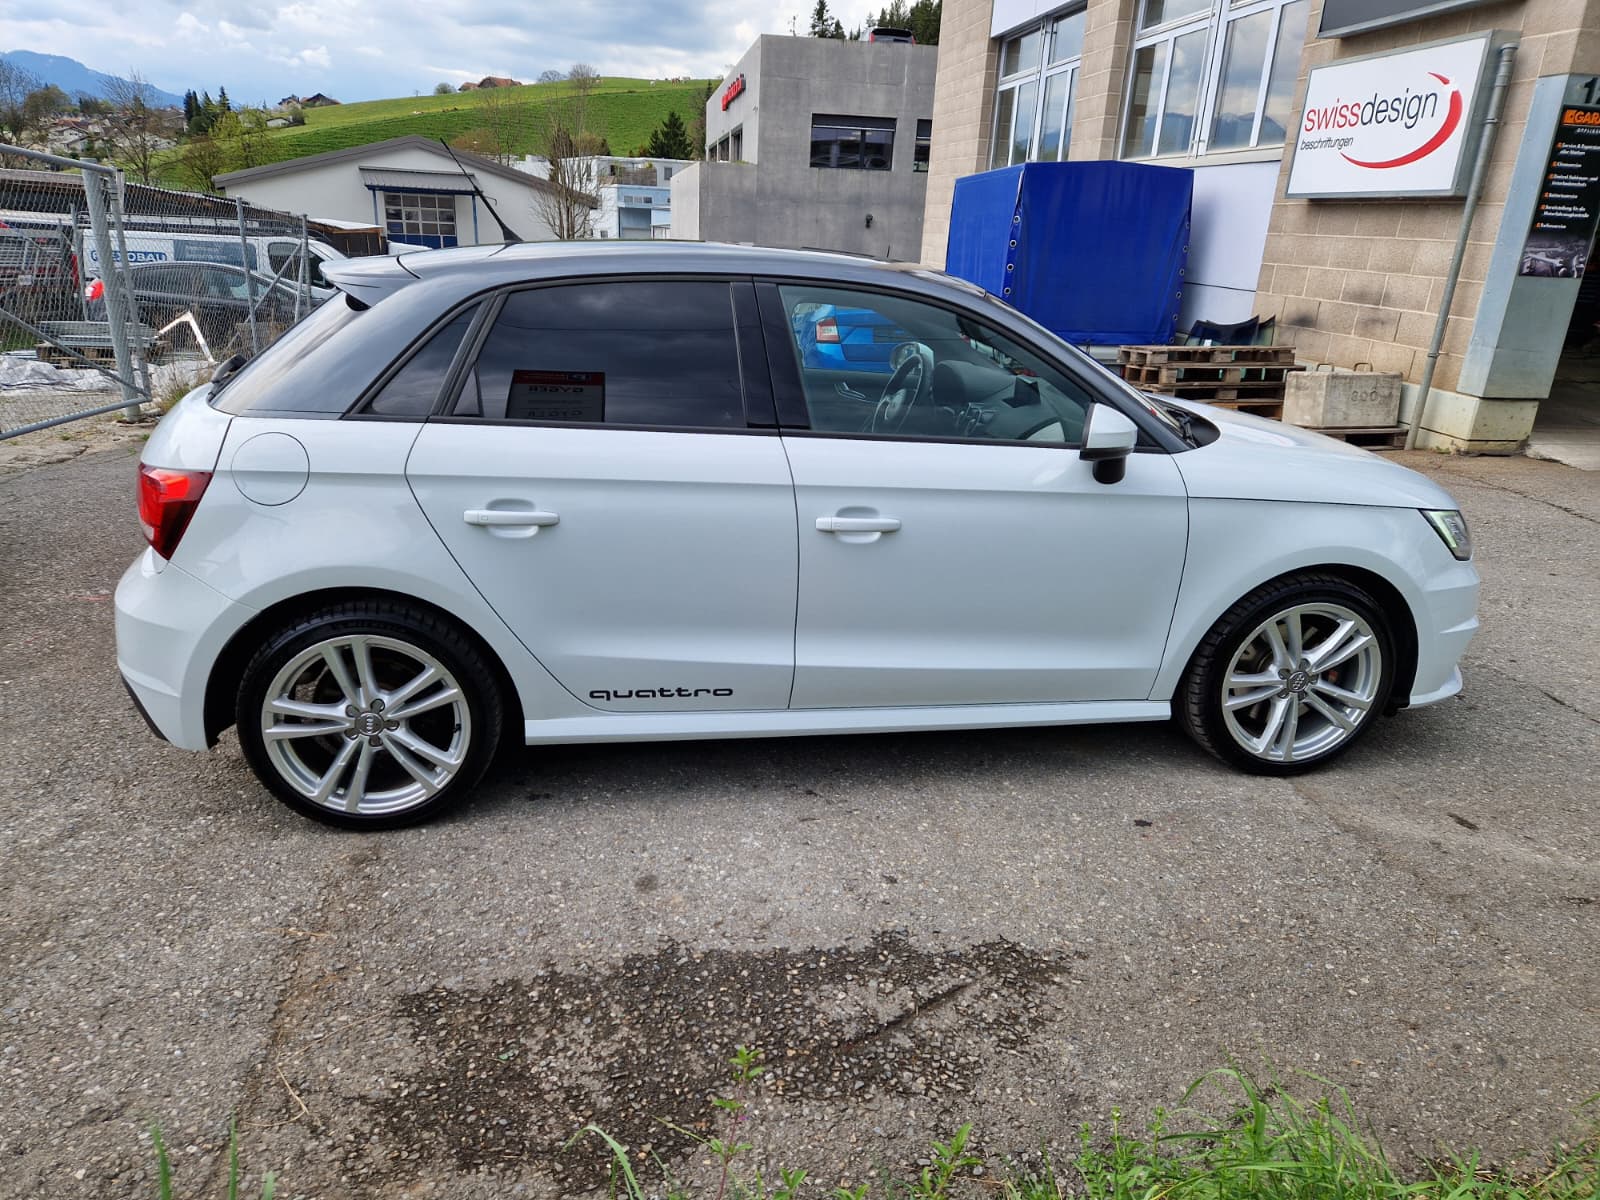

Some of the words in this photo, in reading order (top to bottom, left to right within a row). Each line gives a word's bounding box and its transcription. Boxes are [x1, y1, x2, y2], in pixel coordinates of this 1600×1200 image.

[1304, 88, 1438, 132] swissdesign
[1574, 110, 1600, 125] GAR
[1300, 137, 1354, 150] beschriftungen
[589, 687, 734, 701] quattro
